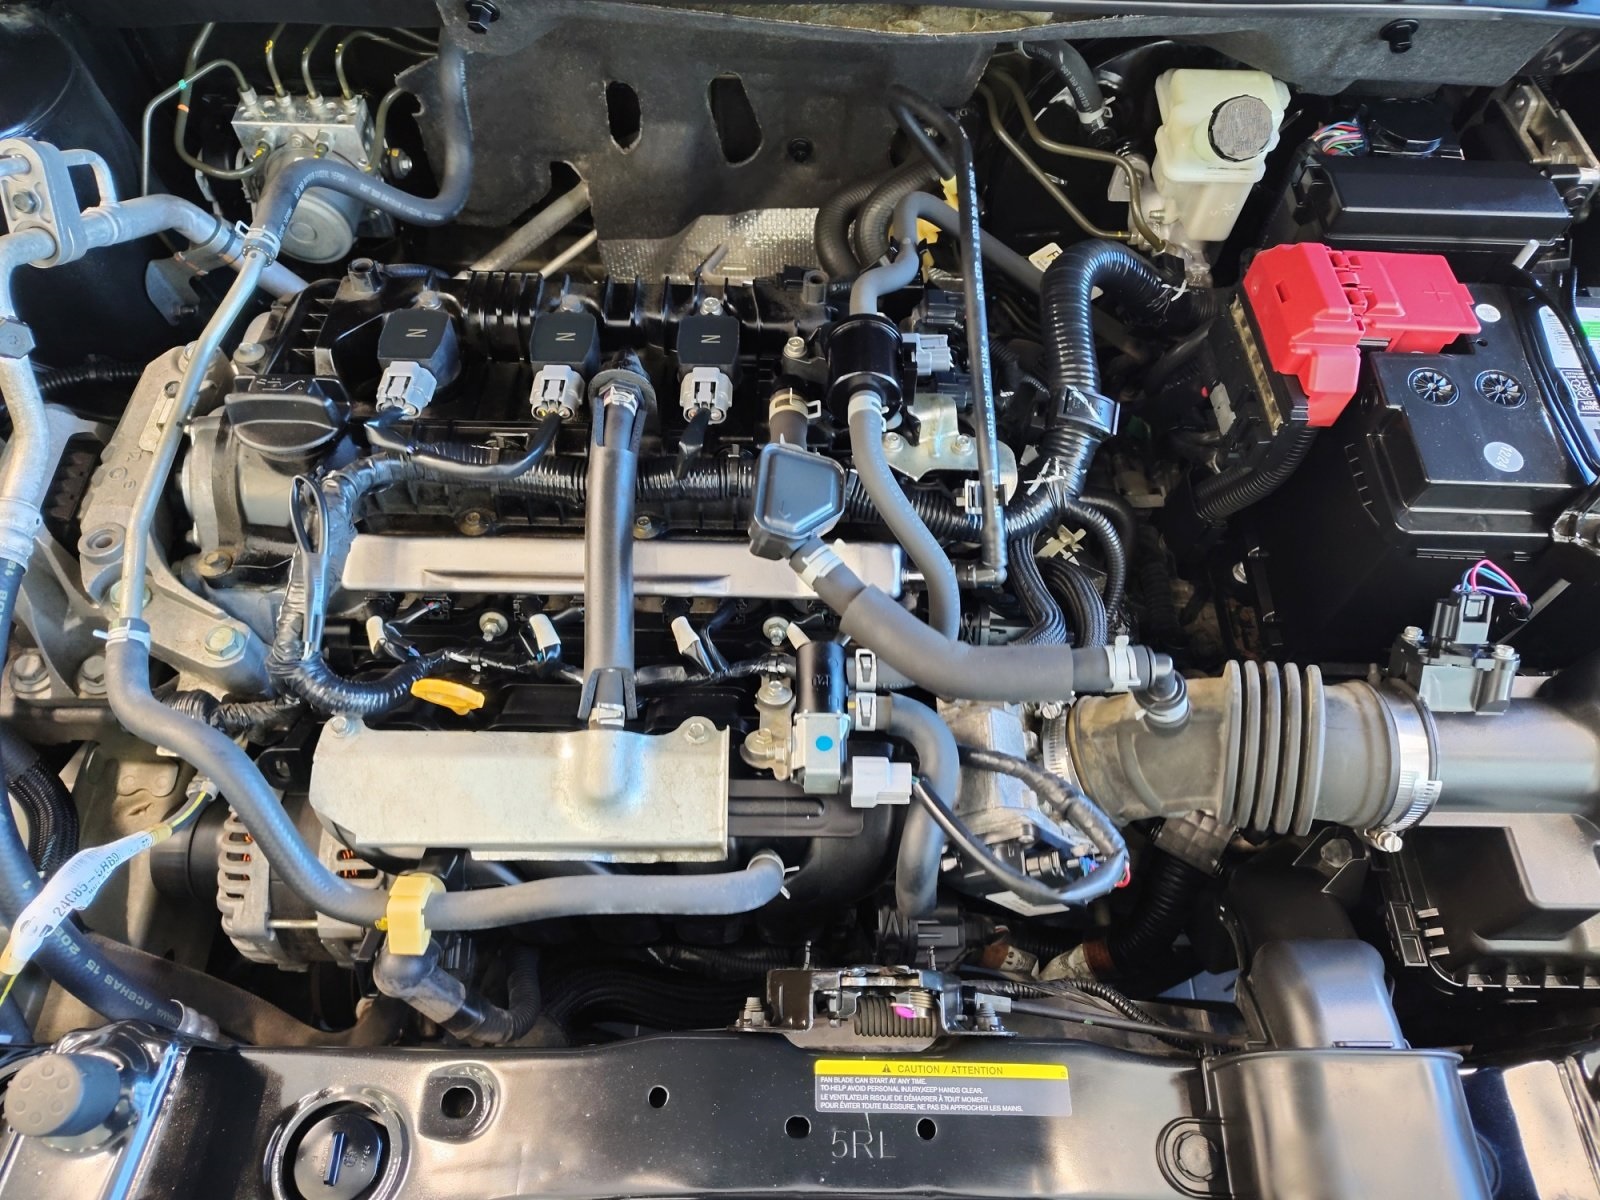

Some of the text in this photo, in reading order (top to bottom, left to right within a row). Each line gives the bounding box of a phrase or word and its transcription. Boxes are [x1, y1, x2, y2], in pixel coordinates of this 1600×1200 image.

[980, 345, 989, 368] KINK
[85, 959, 100, 975] 15
[897, 1064, 940, 1074] CAUTION
[951, 1065, 1003, 1075] ATTENTION
[904, 1093, 937, 1102] DÉMARRER
[840, 1101, 860, 1109] ÉVITER
[832, 1130, 896, 1159] 5RL
